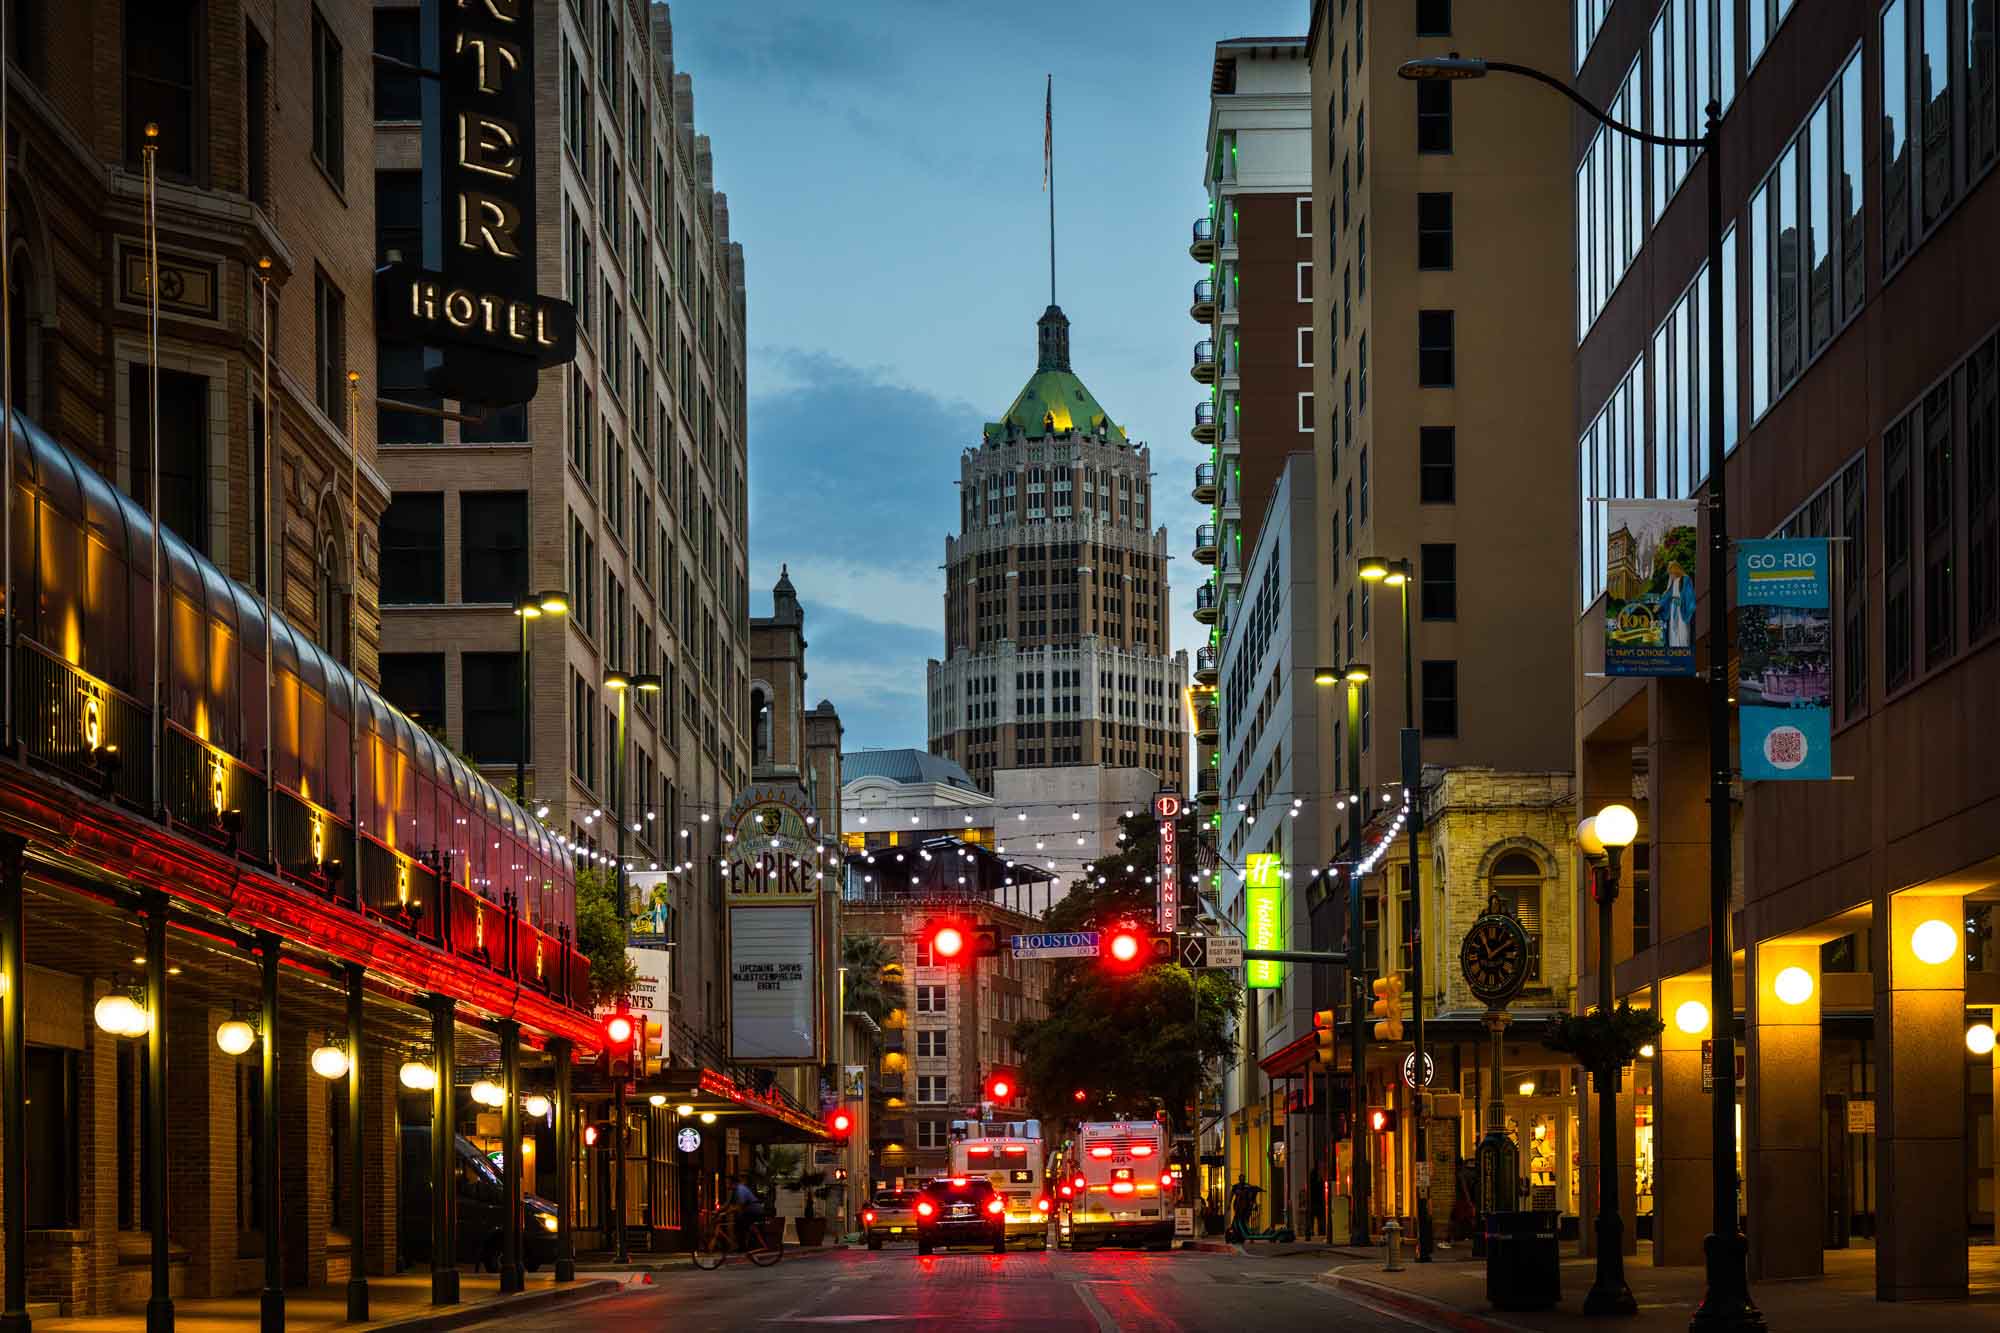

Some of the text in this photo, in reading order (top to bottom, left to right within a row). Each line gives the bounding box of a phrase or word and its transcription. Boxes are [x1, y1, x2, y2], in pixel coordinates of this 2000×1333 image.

[412, 281, 557, 345] HOTEL
[1747, 552, 1817, 569] GO RIO
[1158, 797, 1178, 865] DRURY
[731, 852, 812, 893] EMPIRE
[1020, 934, 1091, 949] HOUSTON
[1116, 1170, 1129, 1179] 42
